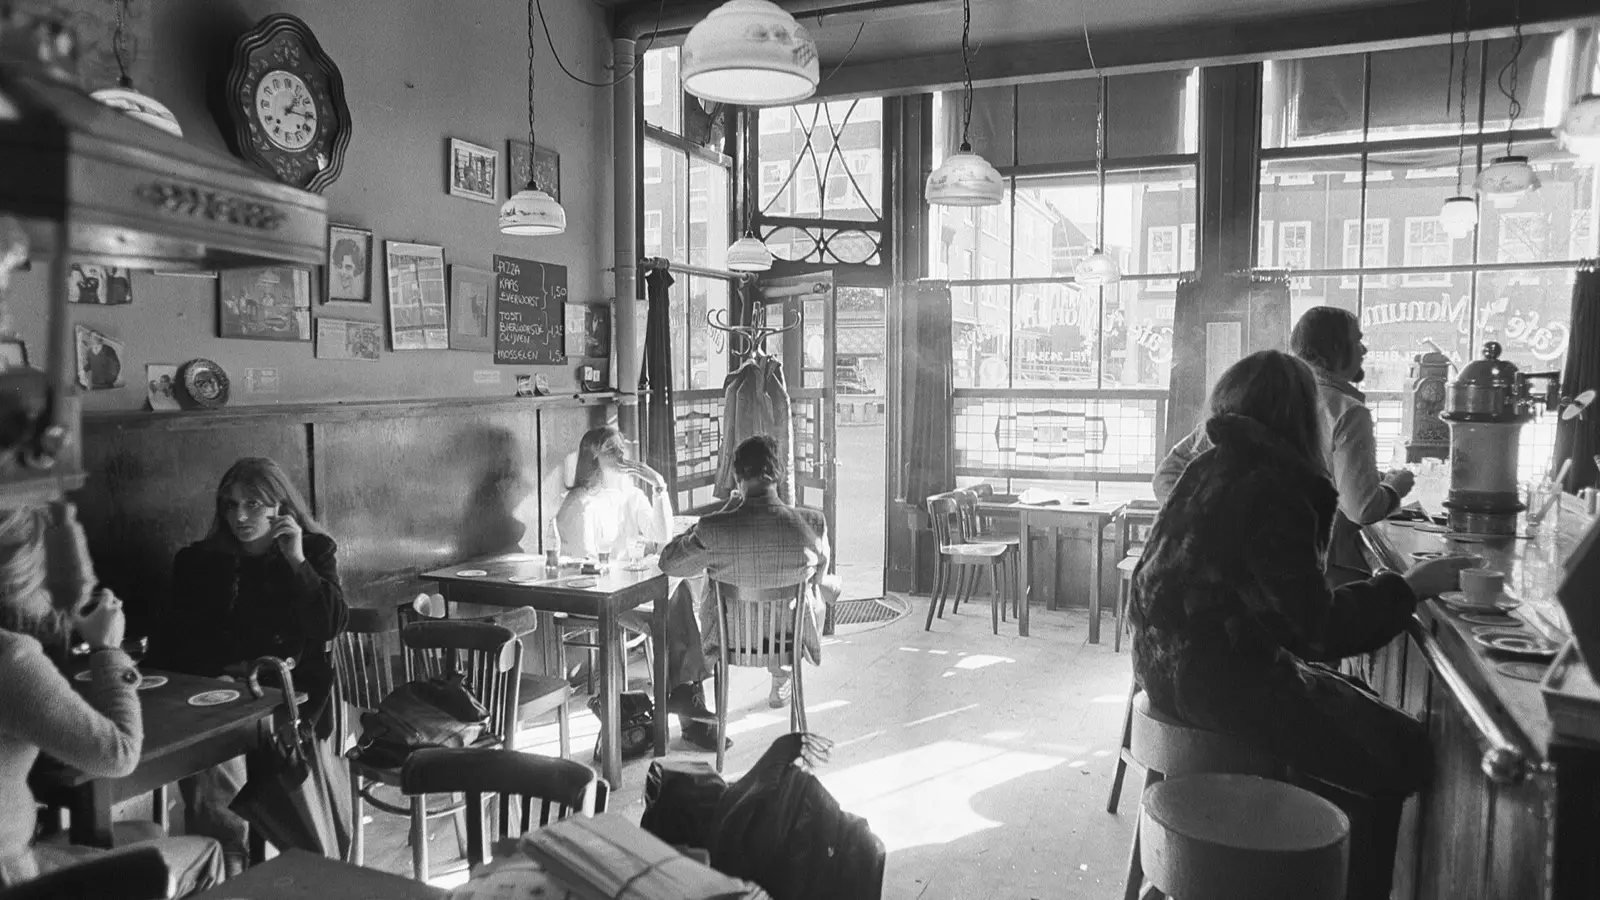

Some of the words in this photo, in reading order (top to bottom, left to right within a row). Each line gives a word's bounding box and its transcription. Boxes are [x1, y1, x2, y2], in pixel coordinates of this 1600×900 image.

[498, 261, 520, 275] PIZZA
[499, 278, 519, 292] KAAS
[551, 286, 567, 299] 1,50
[499, 311, 522, 321] TOSTI
[497, 348, 539, 360] MOSSELEN
